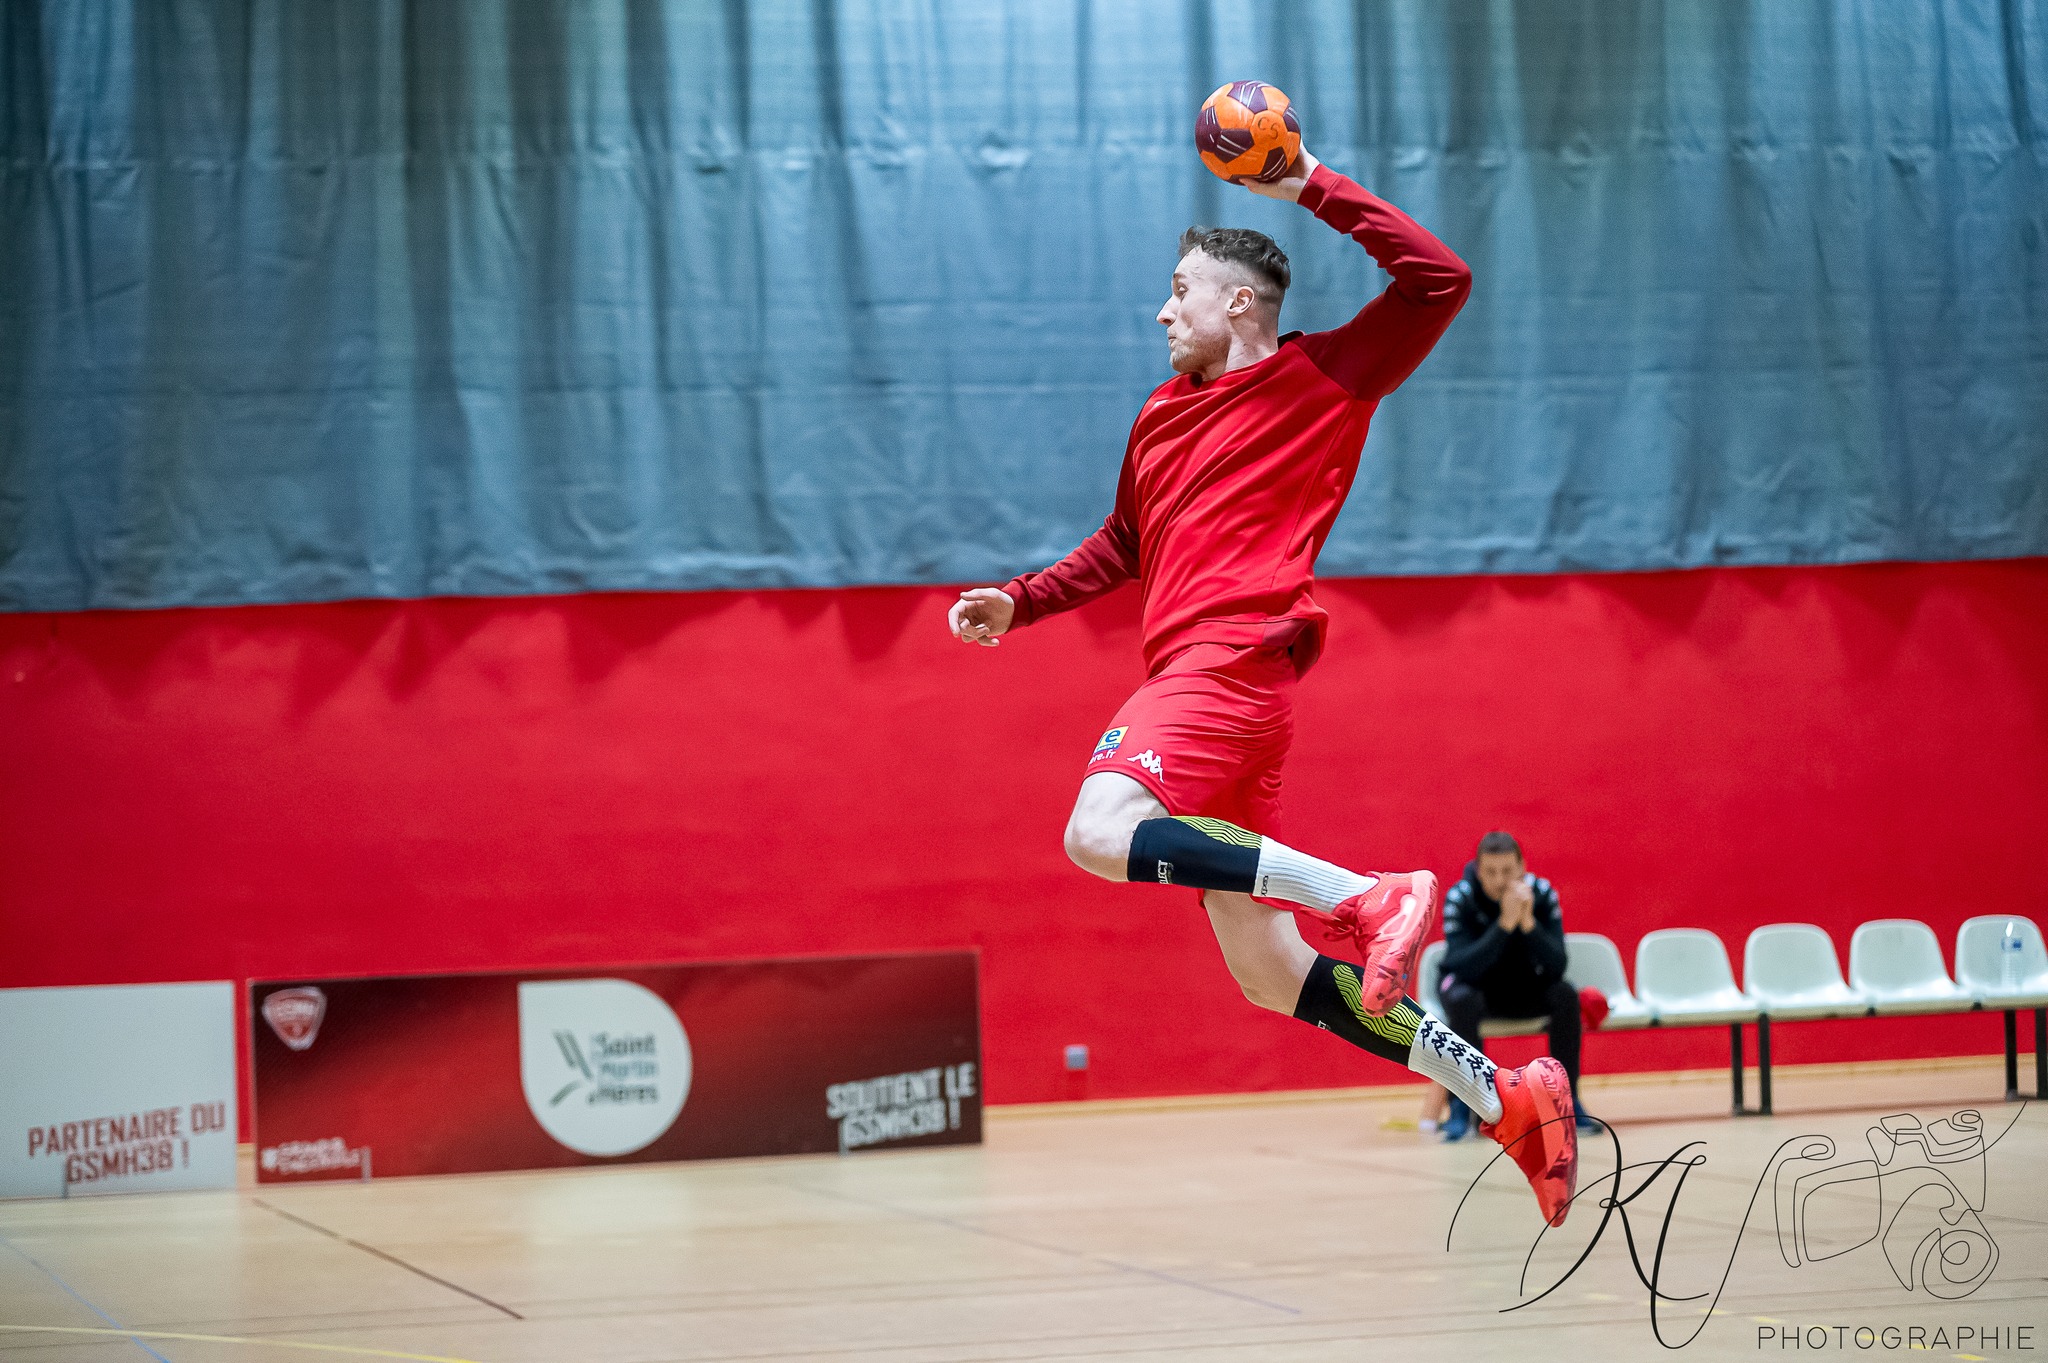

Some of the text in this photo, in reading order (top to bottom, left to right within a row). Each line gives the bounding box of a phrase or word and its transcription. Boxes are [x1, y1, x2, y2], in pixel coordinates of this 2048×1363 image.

[826, 1061, 976, 1119] SOUTIENT LE
[28, 1103, 225, 1159] PARTENAIRE DU
[65, 1138, 174, 1185] GSMH38
